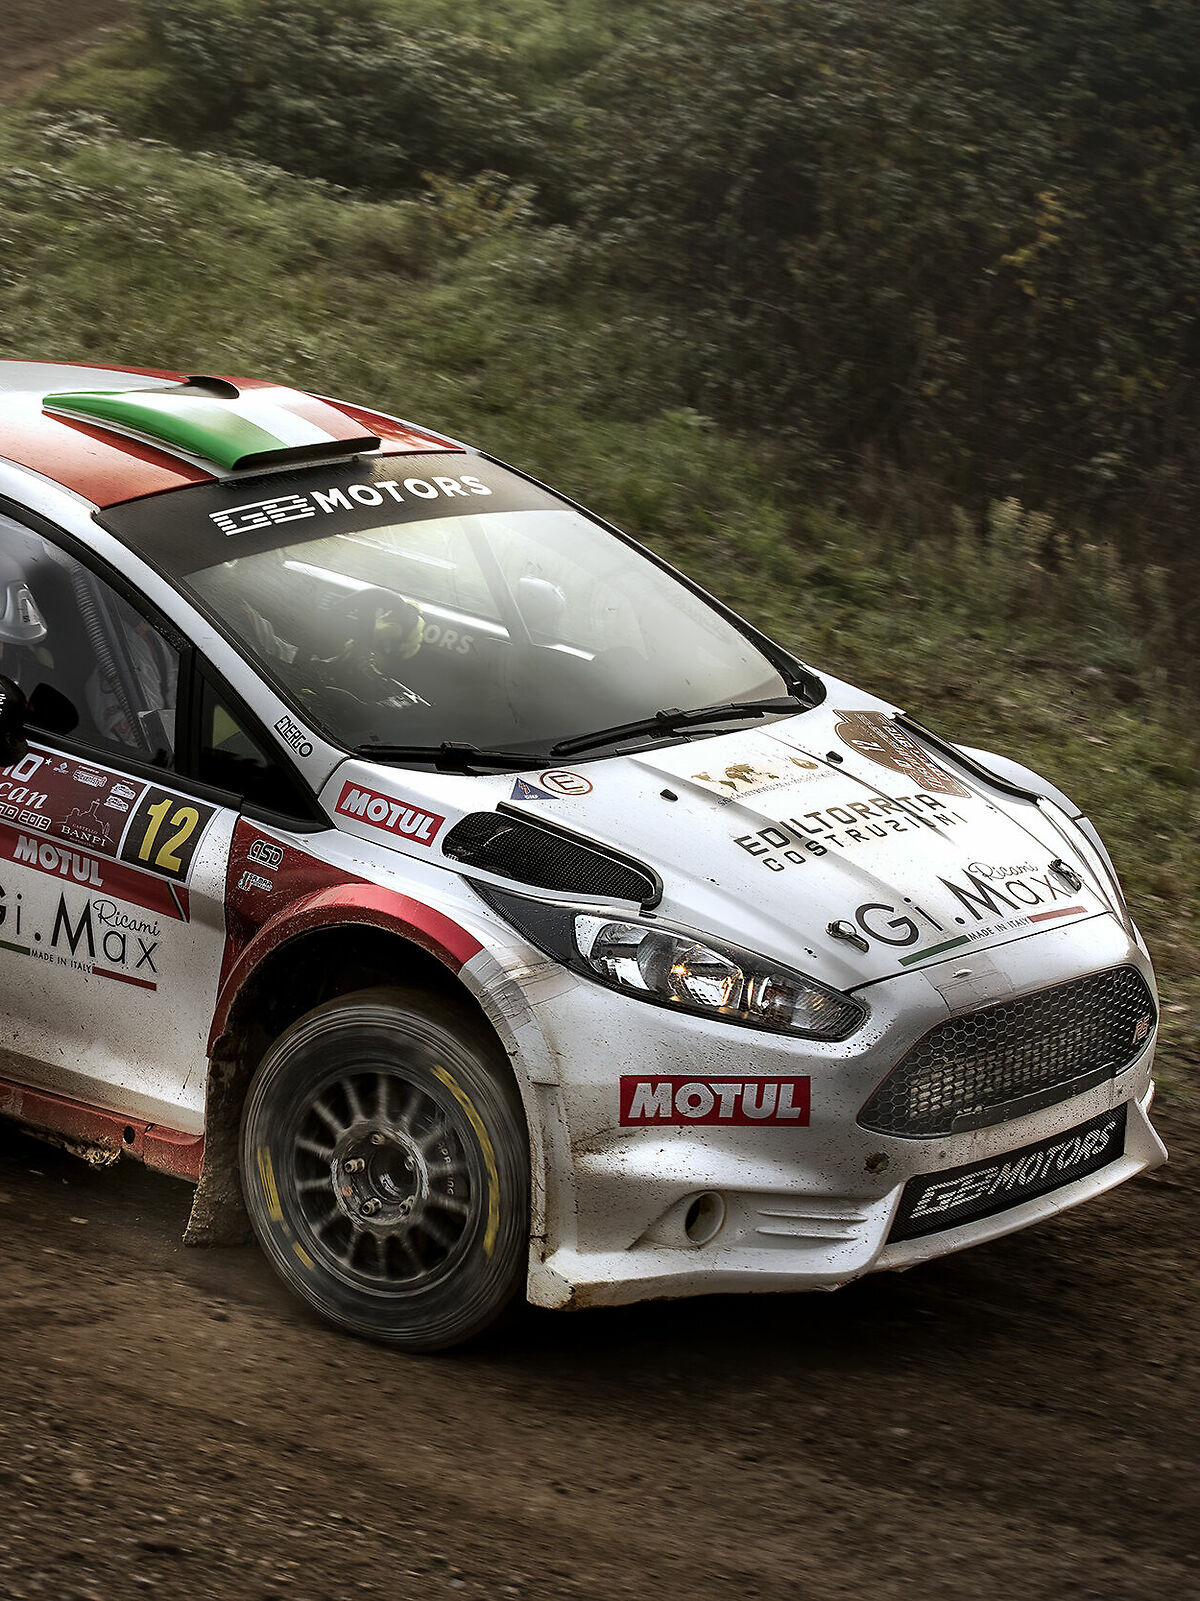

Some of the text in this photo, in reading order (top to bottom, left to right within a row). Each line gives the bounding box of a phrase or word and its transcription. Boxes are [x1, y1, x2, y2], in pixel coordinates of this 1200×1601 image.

[310, 475, 494, 514] MOTORS
[273, 714, 314, 758] ENERGO
[18, 809, 52, 831] 2019
[342, 787, 432, 841] MOTUL
[61, 825, 106, 847] BANFI
[137, 797, 201, 873] 12
[761, 813, 968, 873] COSTRUZIONI
[13, 835, 104, 887] MOTUL
[968, 861, 1039, 882] Ricami
[92, 899, 161, 937] Ricami
[967, 917, 1031, 941] MADE IN ITALY
[31, 949, 92, 974] MADE IN ITALY
[627, 1081, 803, 1120] MOTUL
[987, 1120, 1118, 1195] MOTORS
